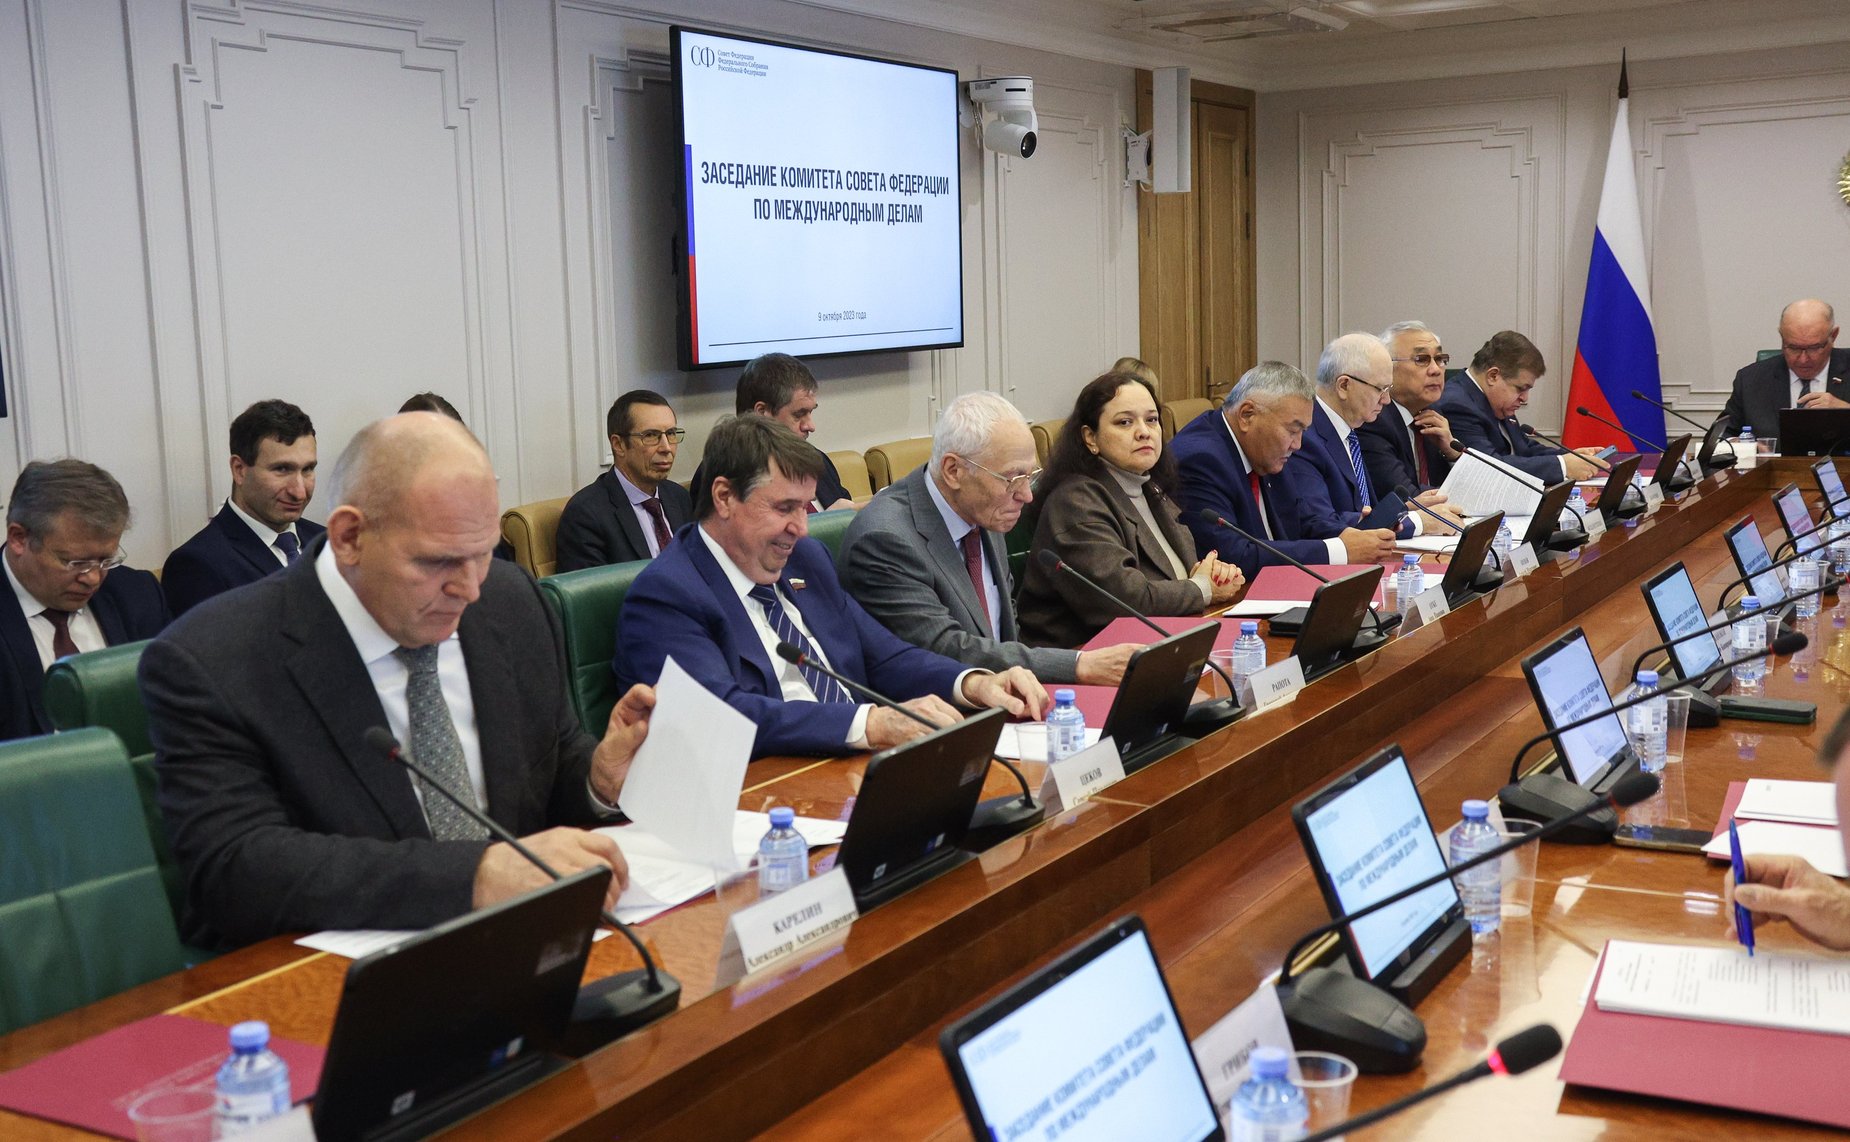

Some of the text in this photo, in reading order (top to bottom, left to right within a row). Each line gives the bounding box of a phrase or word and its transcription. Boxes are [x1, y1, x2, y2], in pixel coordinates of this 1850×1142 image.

[690, 45, 715, 67] СФ
[701, 161, 949, 197] ЗАСЕДАНИЕ КОМИТЕТА СОВЕТА ФЕДЕРАЦИИ
[753, 198, 923, 226] ПО МЕЖДУНАРОДНЫМ ДЕЛАМ
[817, 310, 867, 322] 9 октября 2023 года
[1080, 768, 1102, 786] ЦЕКОВ
[772, 902, 823, 935] КАРЕЛИН
